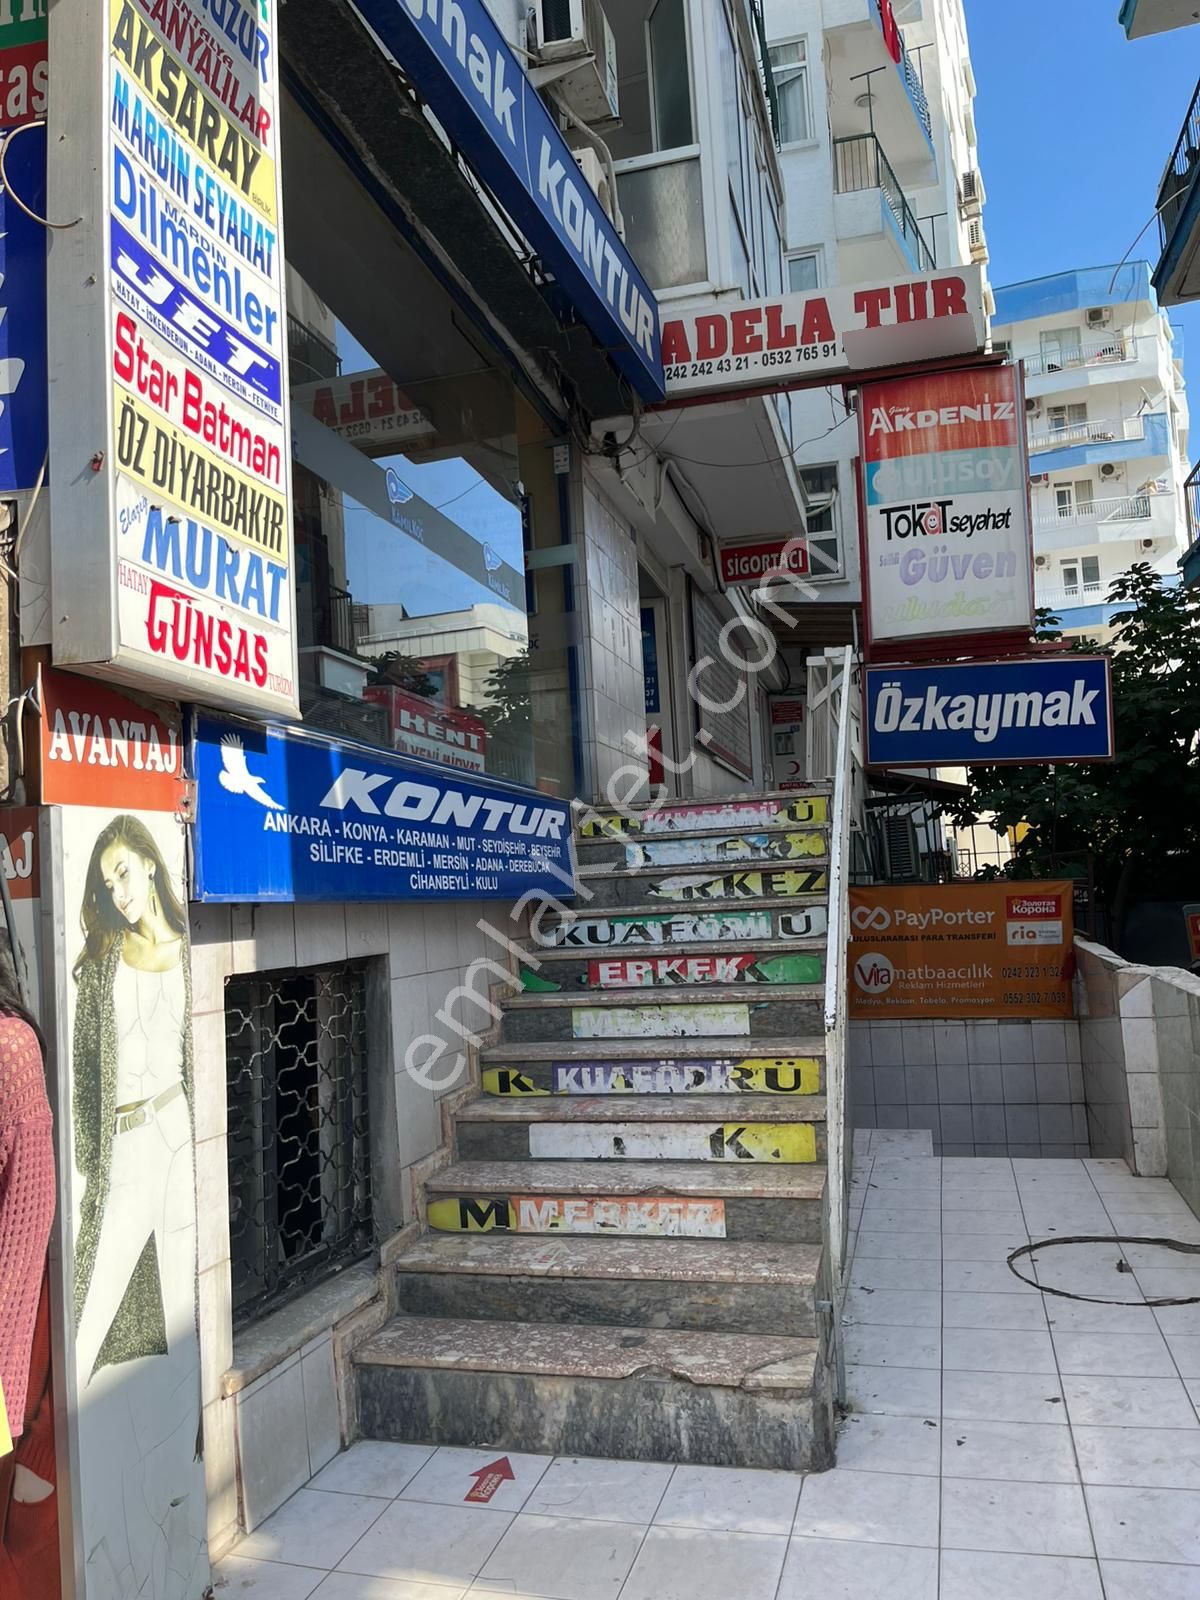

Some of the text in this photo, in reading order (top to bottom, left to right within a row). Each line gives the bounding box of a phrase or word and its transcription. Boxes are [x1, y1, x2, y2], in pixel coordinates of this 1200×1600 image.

[112, 4, 262, 195] AKSARAY
[111, 69, 276, 279] MARDİN SEYAHAT
[114, 145, 278, 346] Dilmenler
[164, 201, 227, 265] MARDİN
[538, 135, 655, 363] KONTUR
[661, 276, 968, 365] ADELA TUR
[116, 281, 279, 418] HATAY İSKENDERUN ADANA MERSİN FETHİYE
[691, 362, 713, 378] 242
[716, 358, 732, 374] 43
[735, 356, 750, 371] 21
[761, 349, 792, 367] 0532
[796, 345, 819, 362] 765
[822, 343, 837, 359] 91
[113, 311, 280, 485] Star Batman
[869, 393, 1015, 437] AKDENİZ
[118, 399, 285, 553] ÖZ DİYARBAKIR
[949, 507, 1012, 538] seyahat
[119, 563, 149, 596] HATAY
[142, 504, 288, 623] MURAT
[727, 549, 804, 576] SİGORTACI
[899, 545, 1017, 586] Güven
[873, 679, 1101, 744] Özkaymak
[48, 708, 178, 774] AVANTAJ
[320, 768, 566, 840] KONTUR
[263, 811, 562, 860] ANKARA KONYA KARAMAN MUT SEYDİŞEHİR BEYŞEHİR
[309, 839, 364, 865] SİLİFKE
[374, 848, 425, 869] ERDEMLİ
[432, 853, 469, 871] MERSİN
[475, 857, 505, 873] ADANA
[410, 870, 499, 890] CİHANBEYLİ KULU
[894, 908, 996, 930] PayPorter
[1011, 925, 1037, 940] ria
[1012, 905, 1056, 915] Корона
[920, 934, 944, 942] PARA
[947, 931, 997, 941] TRANSFERİ
[898, 980, 985, 989] Reklam Hizmetleri
